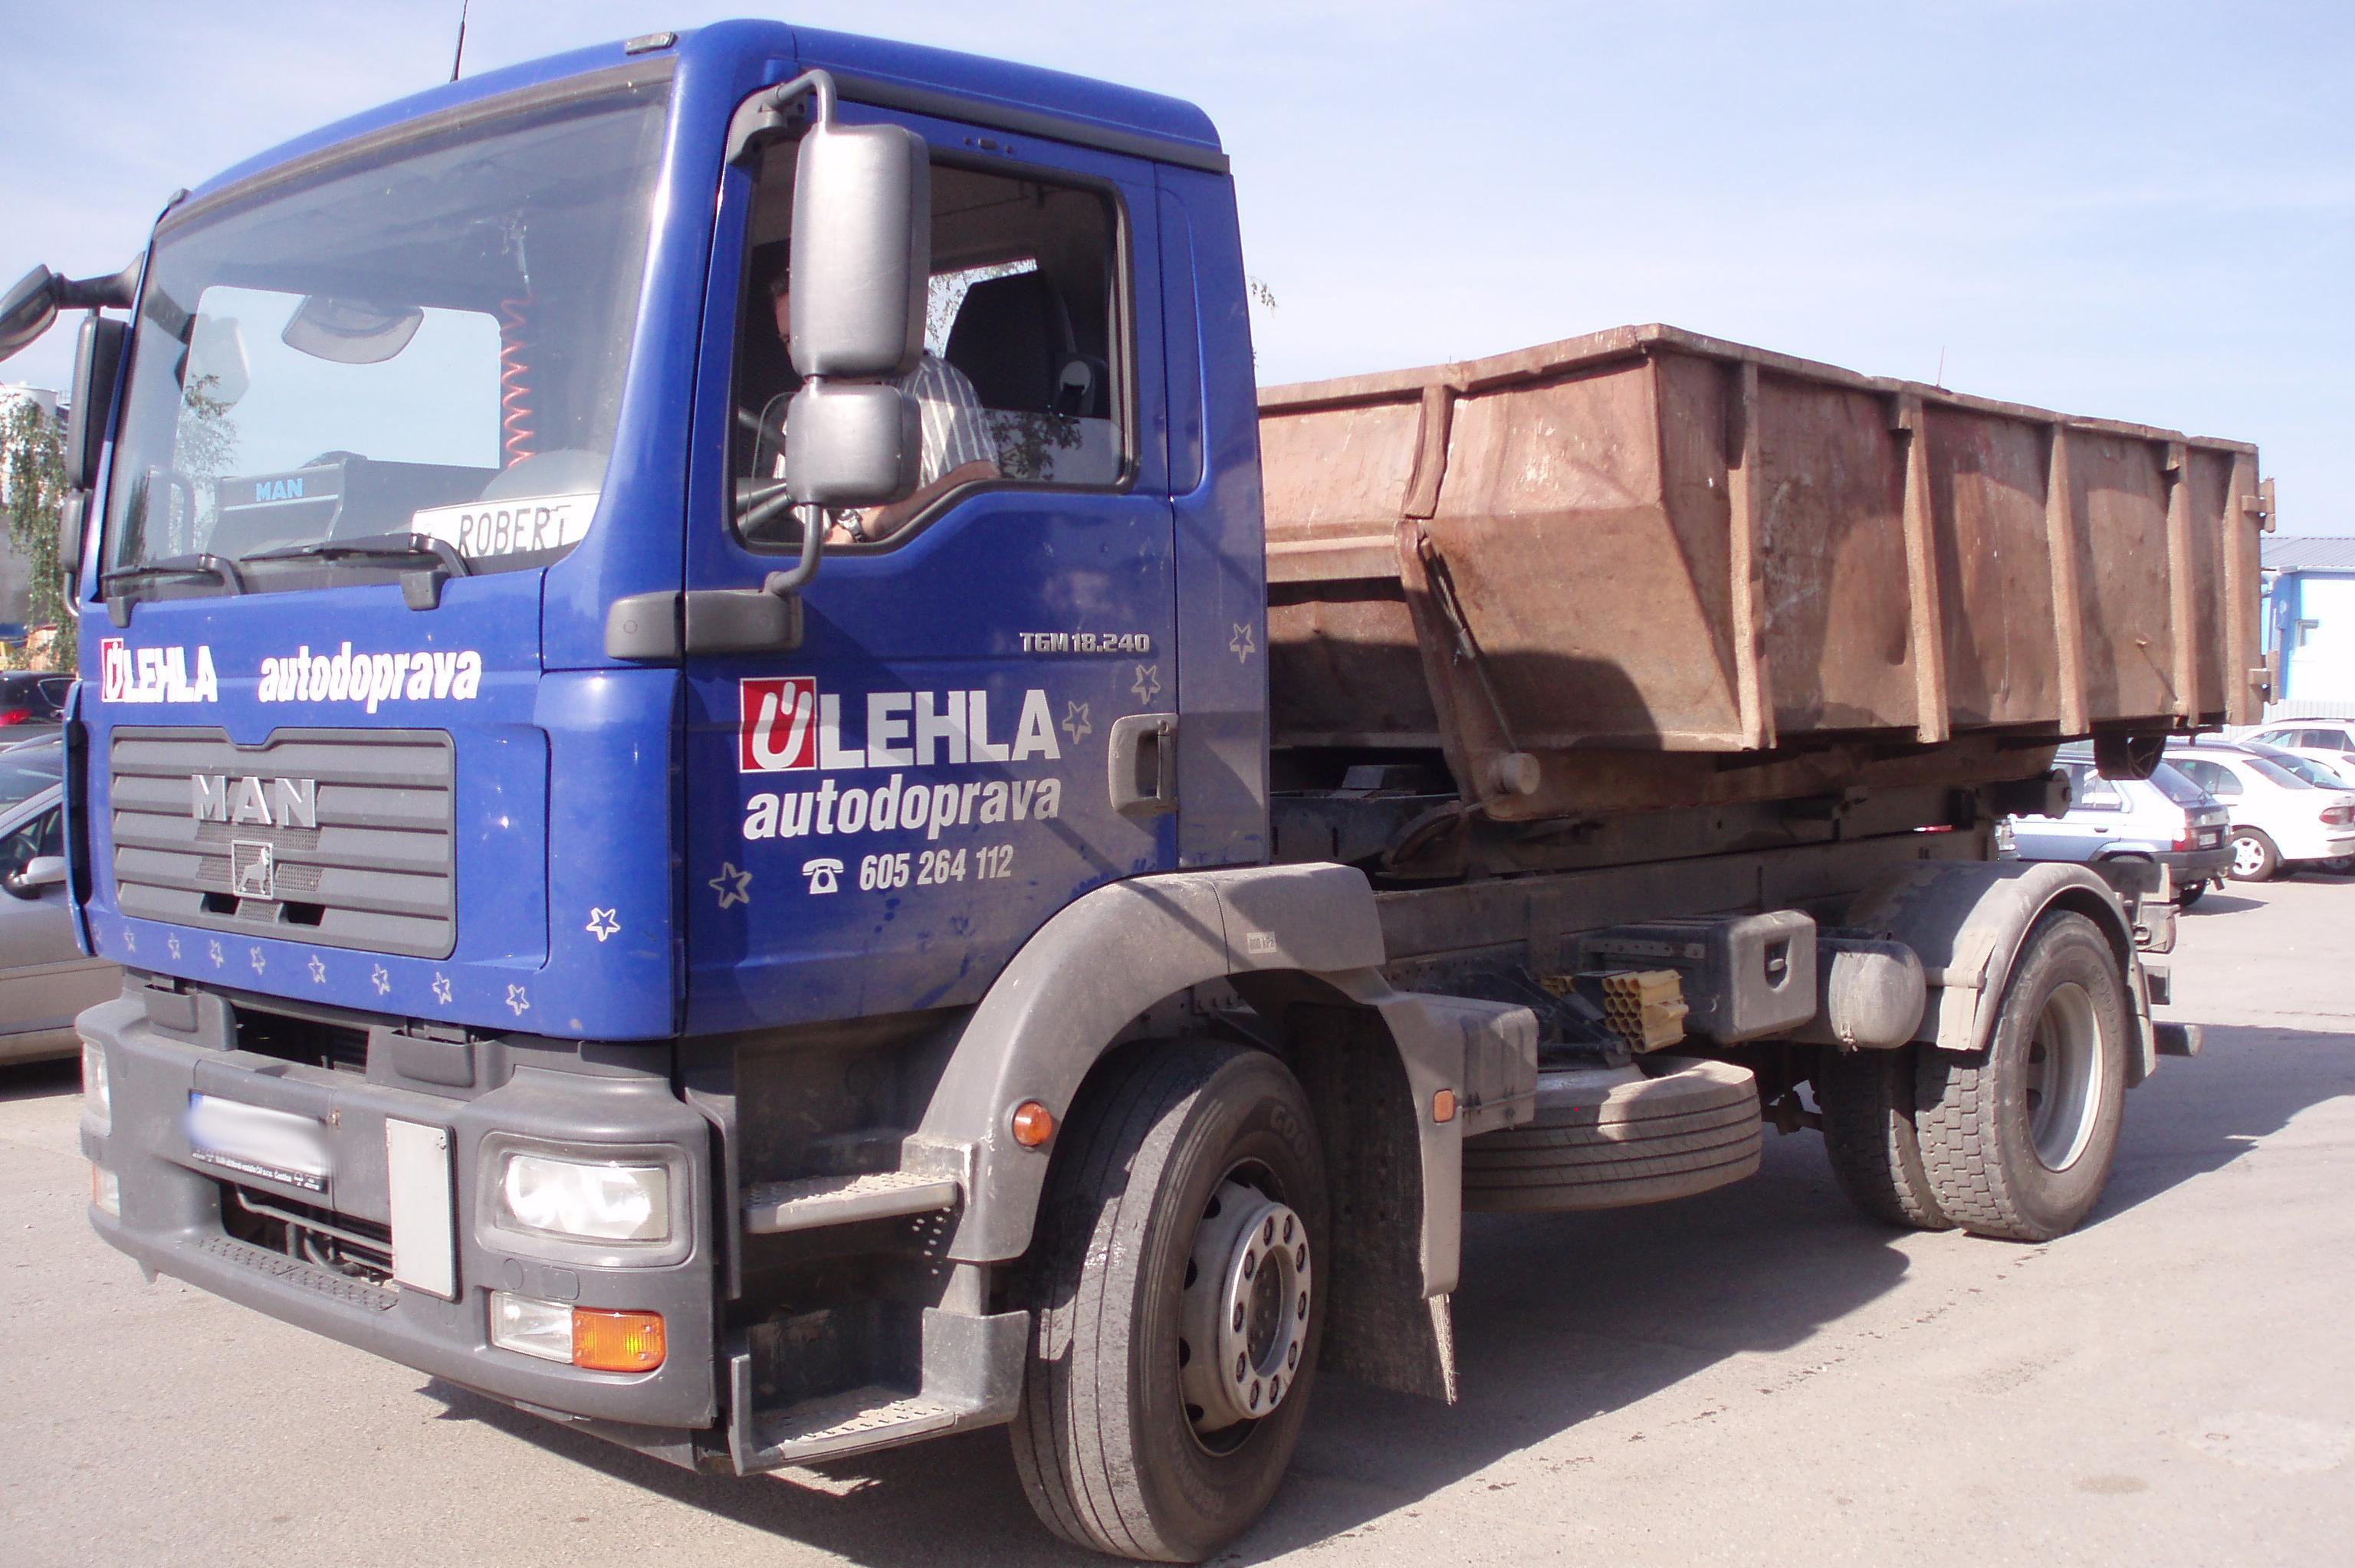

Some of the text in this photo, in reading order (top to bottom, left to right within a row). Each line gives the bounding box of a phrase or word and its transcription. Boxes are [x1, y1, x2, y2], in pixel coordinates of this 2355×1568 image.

[256, 478, 303, 502] MAN
[458, 505, 571, 557] ROBERT
[1020, 632, 1150, 652] TGM 18.240
[258, 641, 481, 713] autodoprava
[192, 774, 316, 828] MAN
[743, 773, 1062, 840] autodoprava
[859, 844, 1014, 891] 605 264 112
